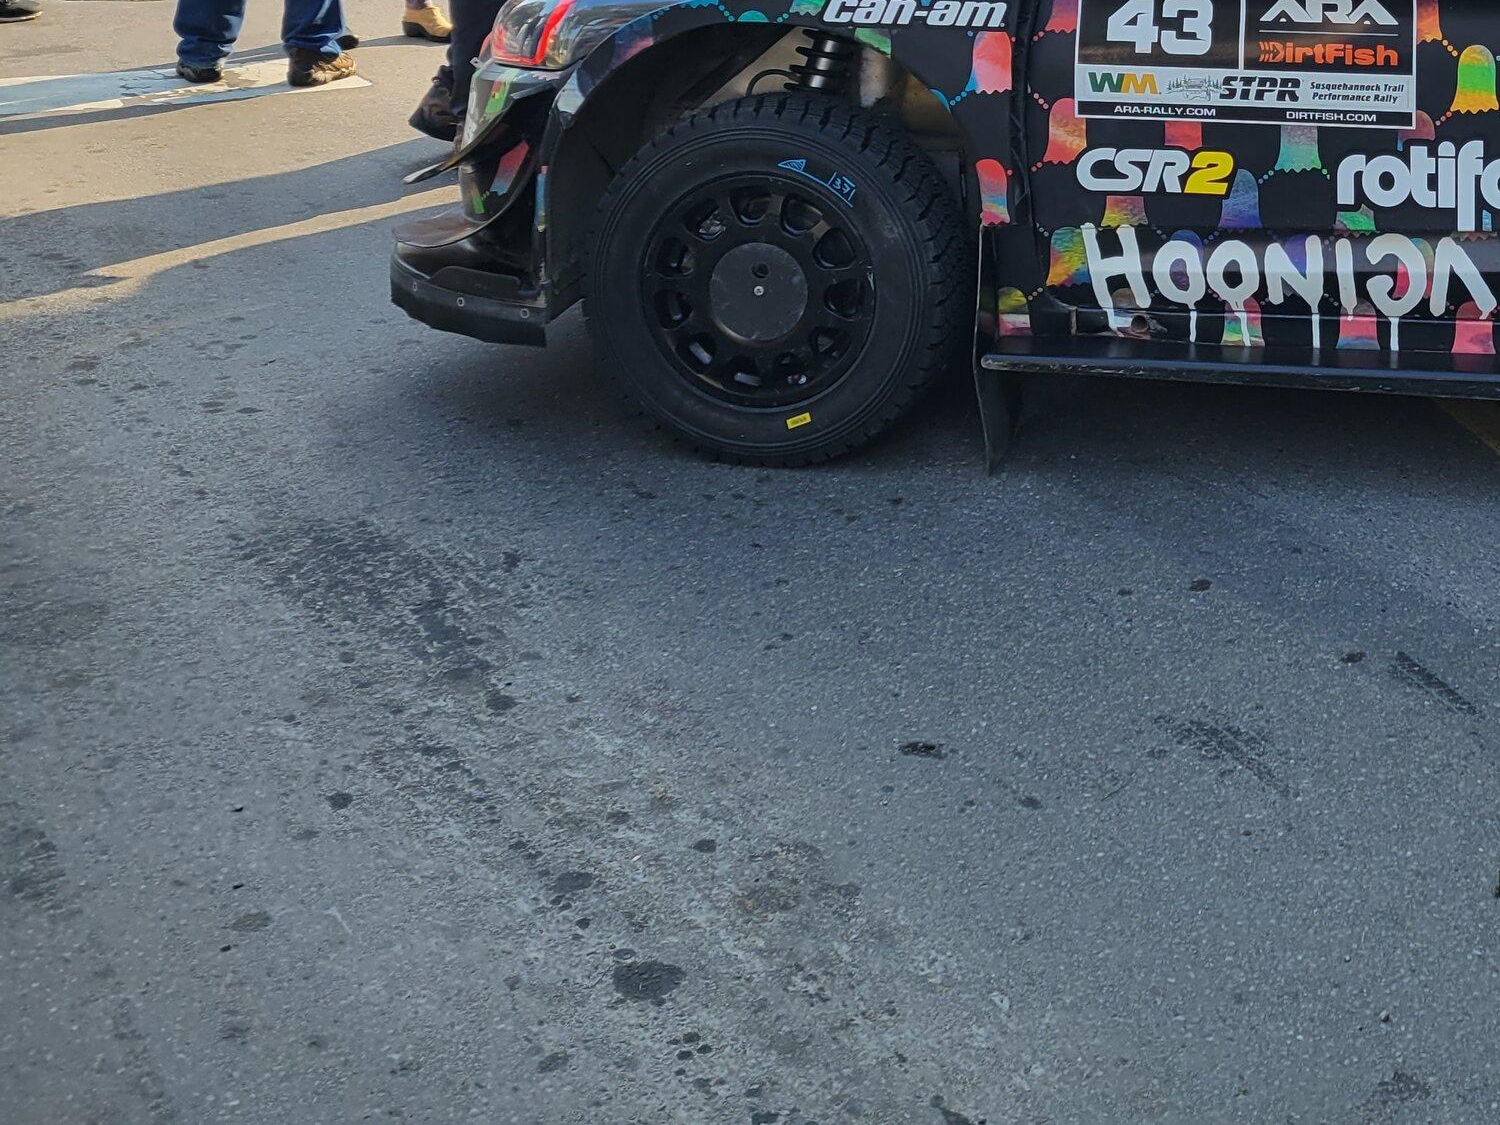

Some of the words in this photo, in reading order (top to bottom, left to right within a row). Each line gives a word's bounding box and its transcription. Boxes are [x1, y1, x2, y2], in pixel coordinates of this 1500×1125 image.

[1258, 40, 1399, 66] DirtFish
[1087, 71, 1162, 95] WM
[1218, 75, 1304, 103] STPR
[1309, 81, 1381, 92] Susquehannock
[1383, 83, 1405, 92] Trail
[1311, 92, 1371, 102] Performance
[1373, 93, 1399, 105] Rally
[1113, 104, 1217, 118] ARA-RALLY.COM
[1286, 111, 1377, 123] DIRTFISH.COM
[1075, 147, 1237, 196] CSR2
